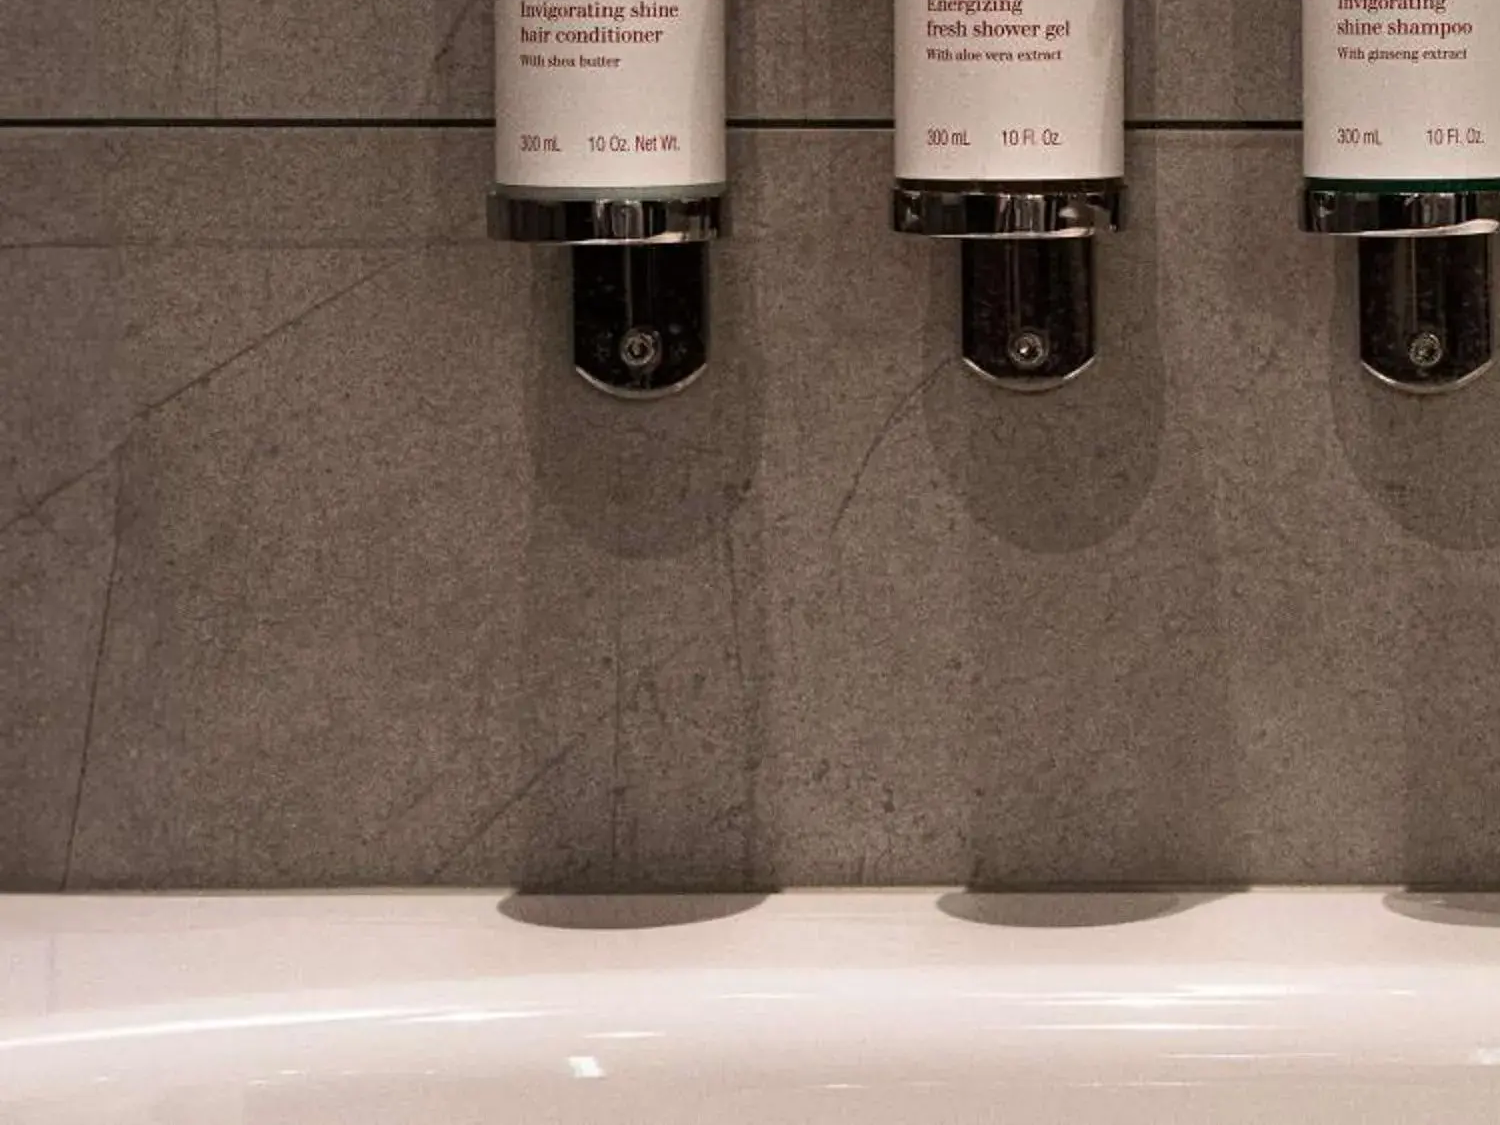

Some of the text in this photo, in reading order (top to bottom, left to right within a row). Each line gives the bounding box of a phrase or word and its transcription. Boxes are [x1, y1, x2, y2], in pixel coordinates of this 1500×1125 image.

[520, 1, 679, 22] Invigorating shine
[520, 27, 663, 43] hair conditioner
[927, 20, 1070, 41] fresh shower gel
[1337, 19, 1472, 38] shine shampoo
[520, 55, 620, 68] With shea butter
[926, 48, 1061, 61] With aloe vera extract
[1338, 47, 1467, 63] With ginseng extract
[589, 135, 604, 151] 10
[609, 135, 630, 151] Oz.
[636, 135, 656, 151] Net
[660, 135, 680, 151] Wt.
[927, 129, 947, 146] 300
[1002, 129, 1018, 146] 10
[1337, 128, 1485, 145] 300 mL 10 Fl. Oz.
